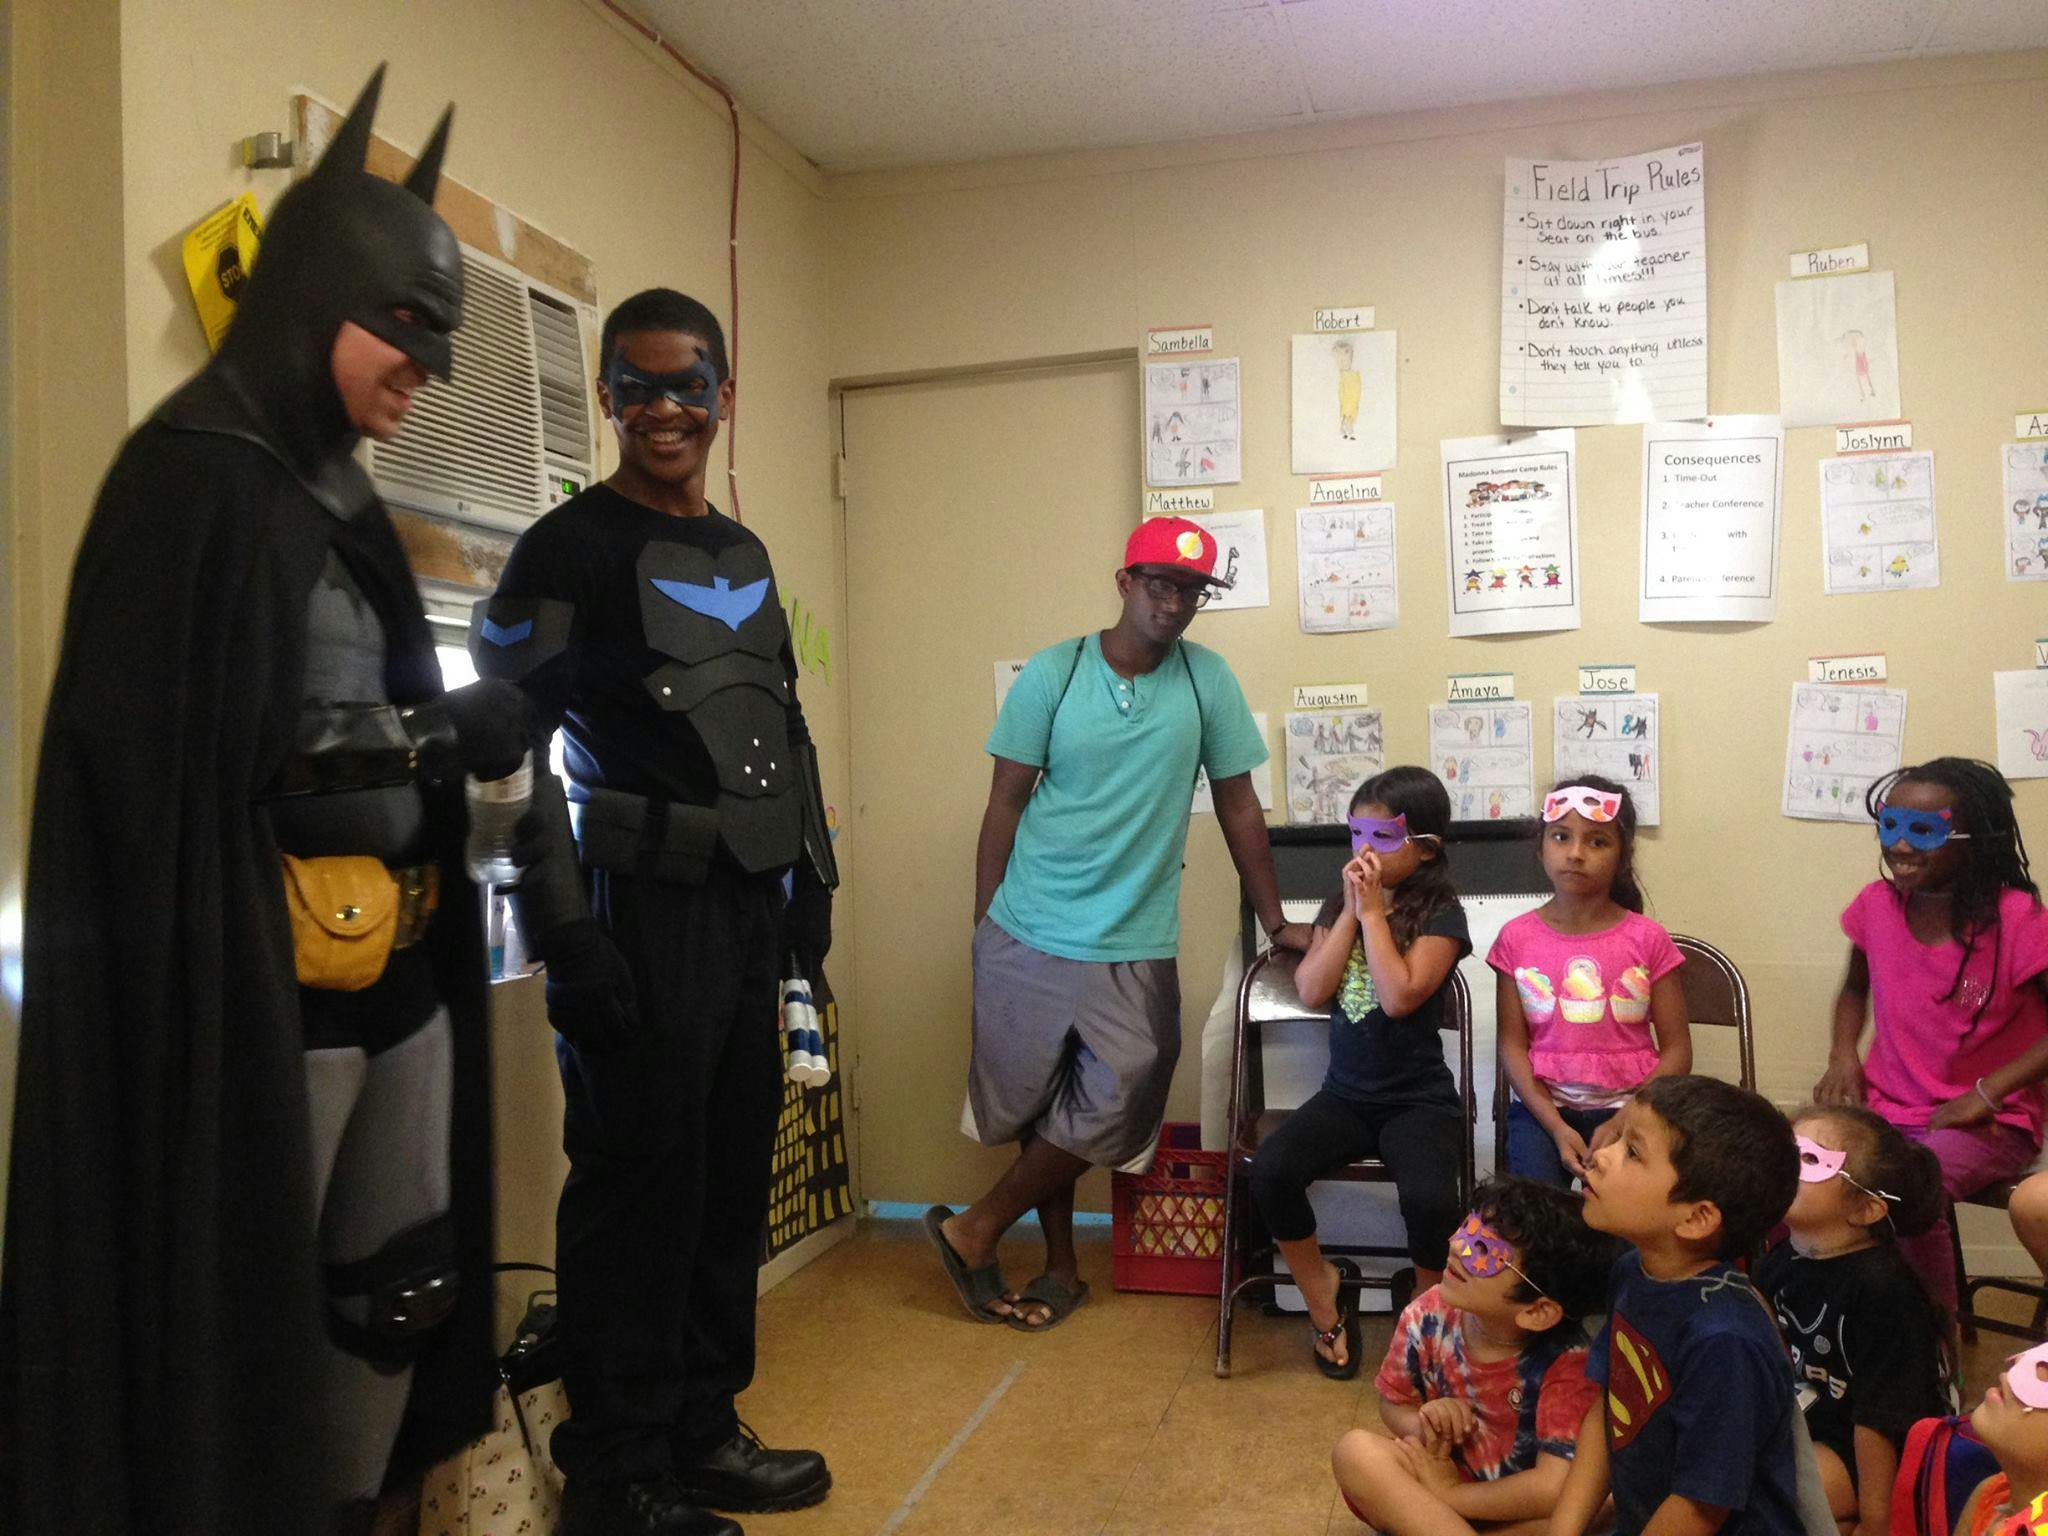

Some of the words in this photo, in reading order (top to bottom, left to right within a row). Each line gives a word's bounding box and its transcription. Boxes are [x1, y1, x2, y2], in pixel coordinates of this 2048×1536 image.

[1533, 164, 1590, 201] Field
[1595, 166, 1640, 204] Trip
[1647, 160, 1701, 191] Rules
[1527, 212, 1552, 230] Sit
[1556, 217, 1595, 230] down
[1601, 214, 1637, 231] right
[1642, 214, 1656, 224] in
[1661, 205, 1695, 225] your
[1576, 234, 1594, 243] on
[1603, 230, 1628, 241] the
[1529, 255, 1560, 273] Stay
[1566, 261, 1593, 272] with
[1634, 250, 1691, 267] teacher
[1807, 252, 1856, 273] Ruben
[1544, 276, 1559, 287] at
[1567, 274, 1586, 286] all
[1527, 298, 1559, 315] Don't
[1600, 302, 1611, 313] to
[1617, 299, 1656, 316] people
[1664, 296, 1686, 313] you
[1315, 311, 1360, 330] Robert
[1538, 315, 1564, 330] don't
[1150, 333, 1210, 352] Sambella
[1528, 342, 1561, 358] Don't
[1568, 344, 1603, 356] touch
[1608, 342, 1659, 359] anything
[1667, 336, 1703, 351] unless
[1540, 360, 1566, 374] they
[1574, 360, 1590, 371] tell
[1598, 360, 1620, 374] you
[1840, 428, 1905, 452] Joslynn
[1664, 453, 1761, 467] Consequences
[1458, 470, 1489, 479] Madonna
[1490, 467, 1518, 475] Summer
[1519, 465, 1538, 473] Camp
[1675, 473, 1717, 482] Time-Out
[1149, 493, 1210, 510] Matthew
[1312, 482, 1379, 504] Angelina
[1712, 499, 1764, 509] Conference
[1727, 530, 1748, 539] with
[1582, 669, 1629, 691] Jose
[1816, 660, 1878, 682] Jenesis
[1296, 688, 1358, 709] Augustin
[1449, 679, 1499, 700] Amaya
